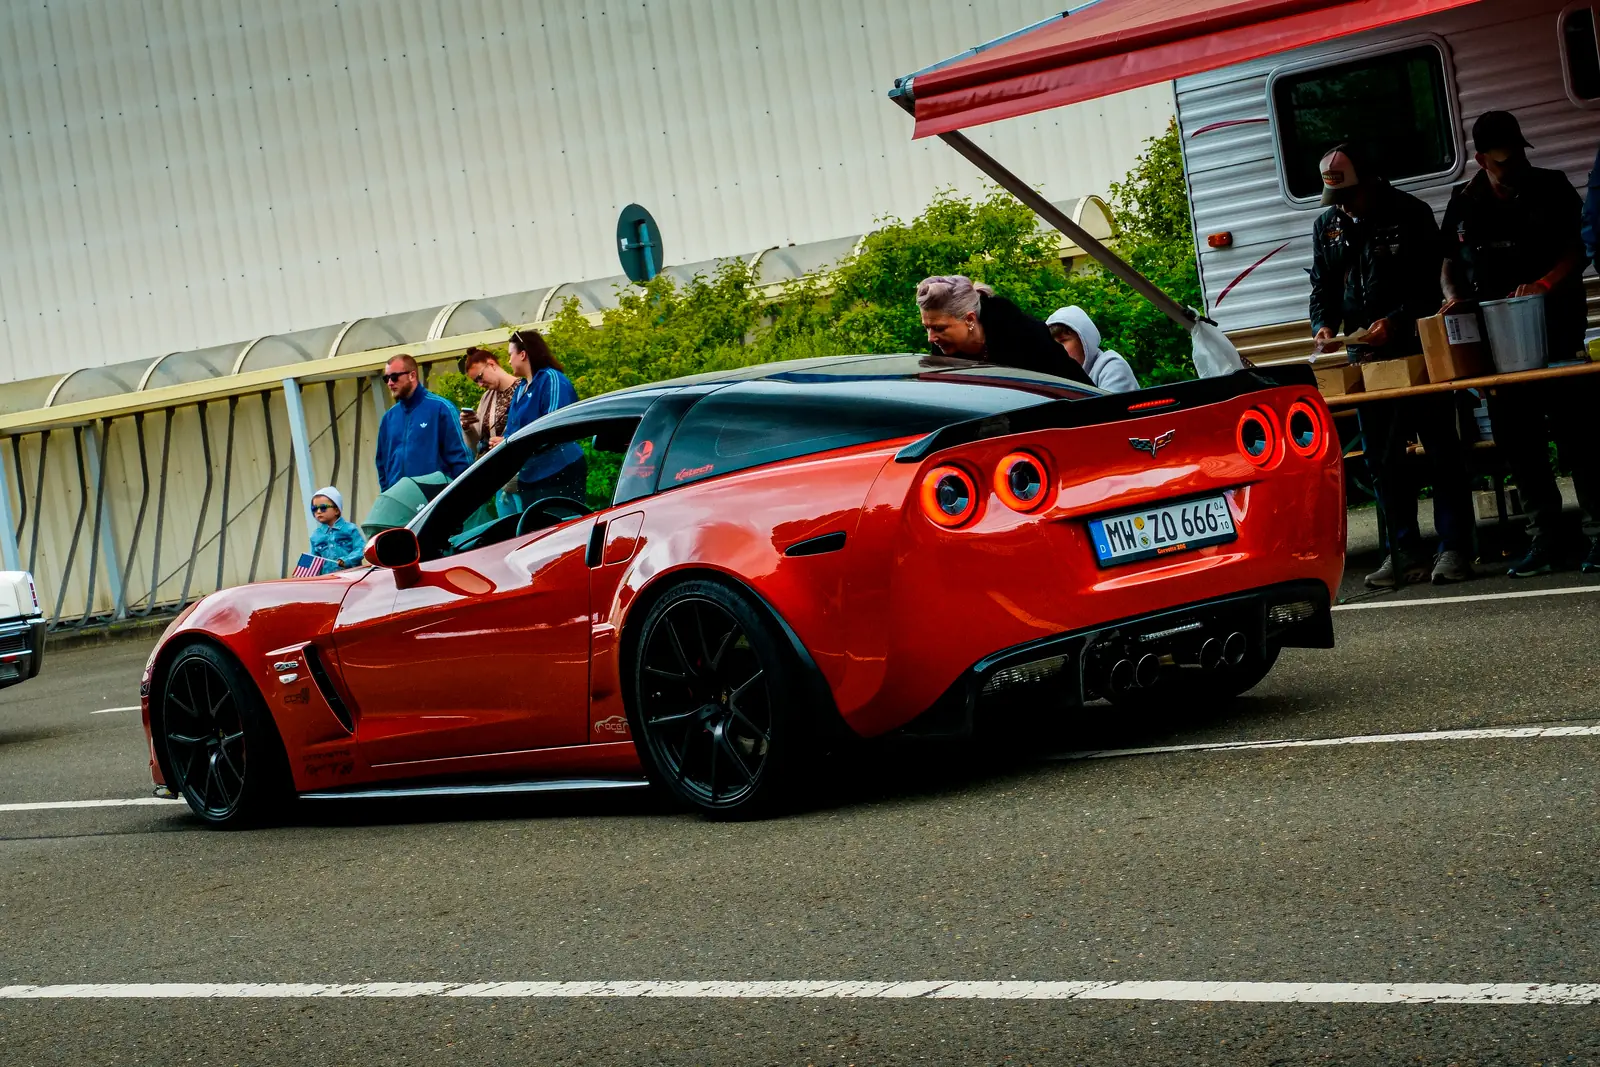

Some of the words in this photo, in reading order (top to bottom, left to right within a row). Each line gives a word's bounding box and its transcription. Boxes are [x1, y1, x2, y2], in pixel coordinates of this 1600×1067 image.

[1214, 501, 1224, 511] 04
[1105, 519, 1137, 552] MW
[1147, 511, 1178, 544] ZO
[1181, 503, 1218, 537] 666
[1220, 522, 1230, 530] 10
[1100, 544, 1107, 554] D
